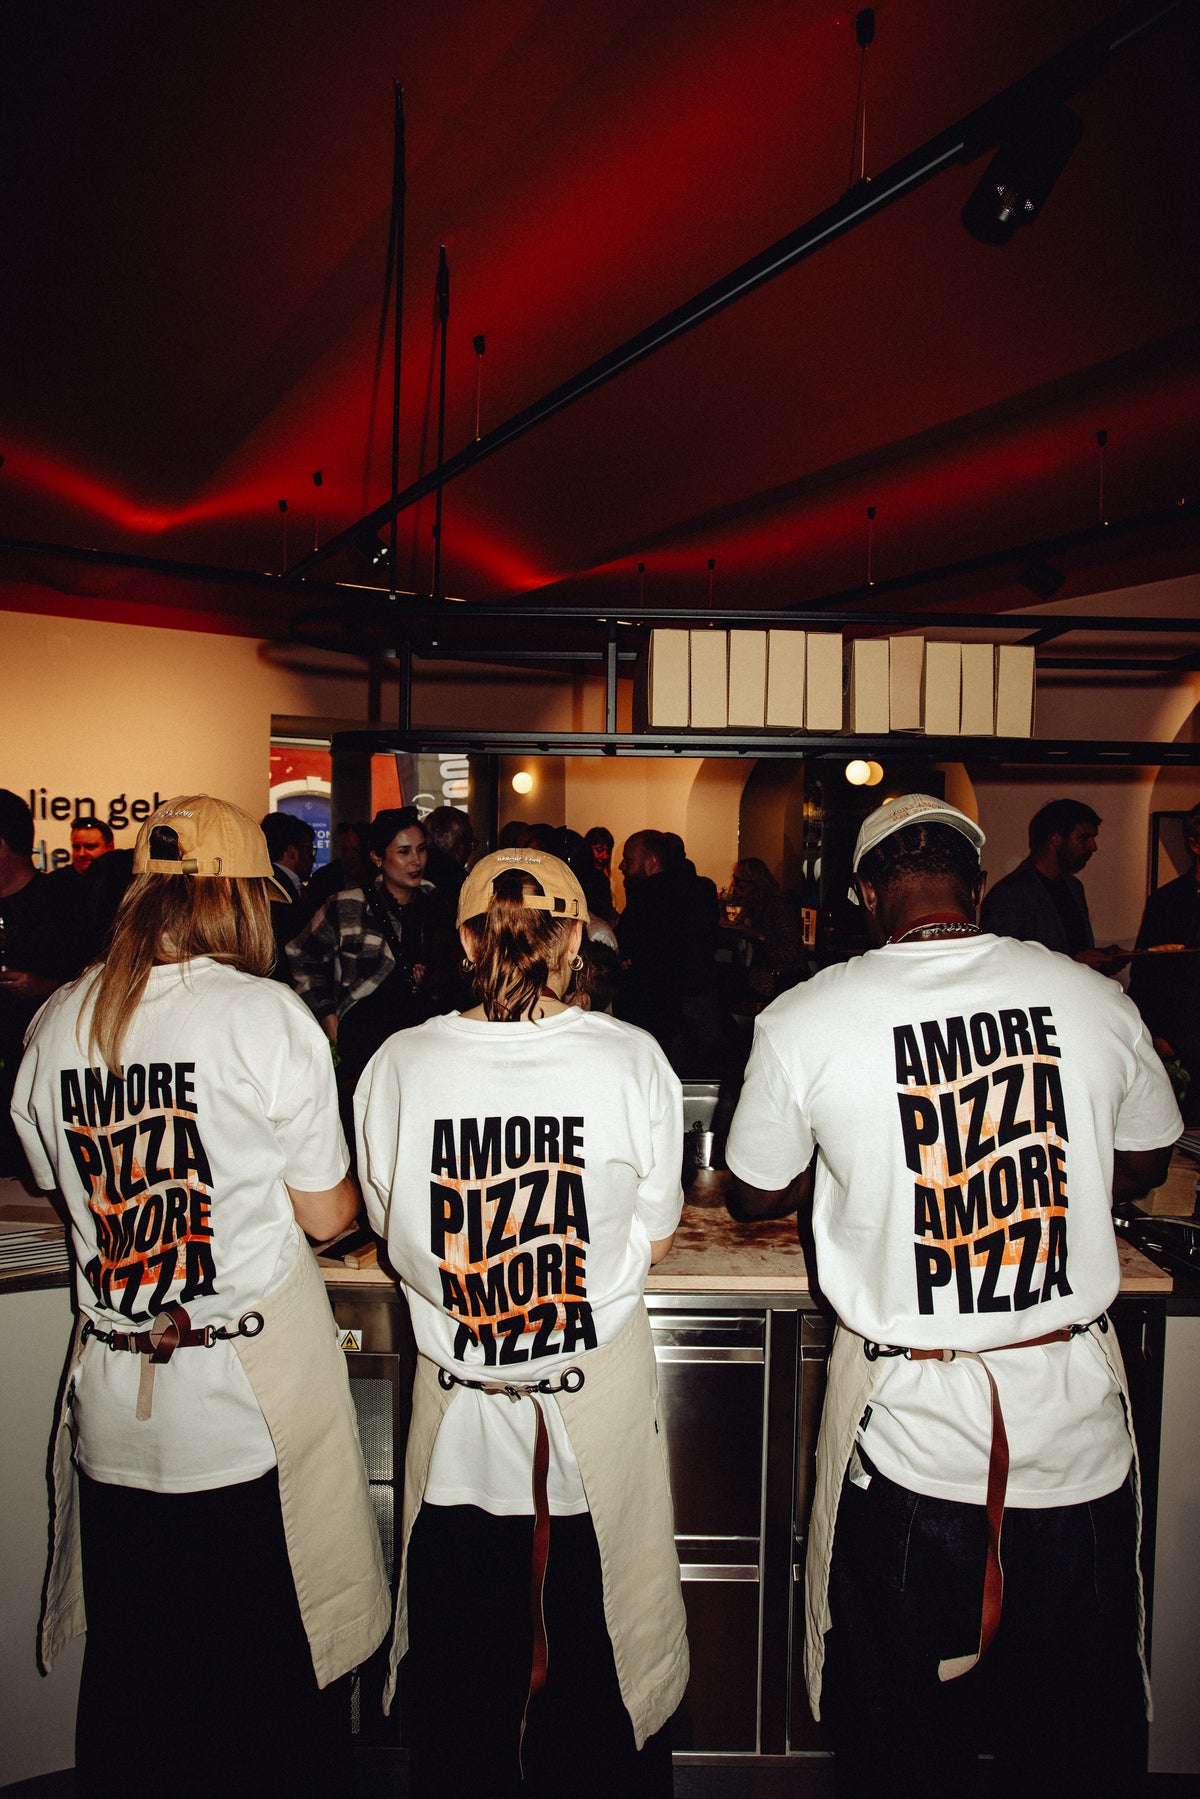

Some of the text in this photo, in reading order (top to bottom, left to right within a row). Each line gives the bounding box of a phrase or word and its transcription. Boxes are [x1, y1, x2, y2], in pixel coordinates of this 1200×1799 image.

[30, 788, 95, 820] lien
[892, 1006, 1061, 1086] AMORE
[60, 1062, 198, 1127] AMORE
[897, 1063, 1069, 1176] PIZZA
[64, 1115, 214, 1206] PIZZA
[430, 1116, 586, 1180] AMORE
[90, 1186, 215, 1262] AMORE
[429, 1170, 590, 1265] PIZZA
[914, 1144, 1069, 1240] AMORE
[438, 1243, 588, 1317] AMORE
[913, 1216, 1074, 1315] PIZZA
